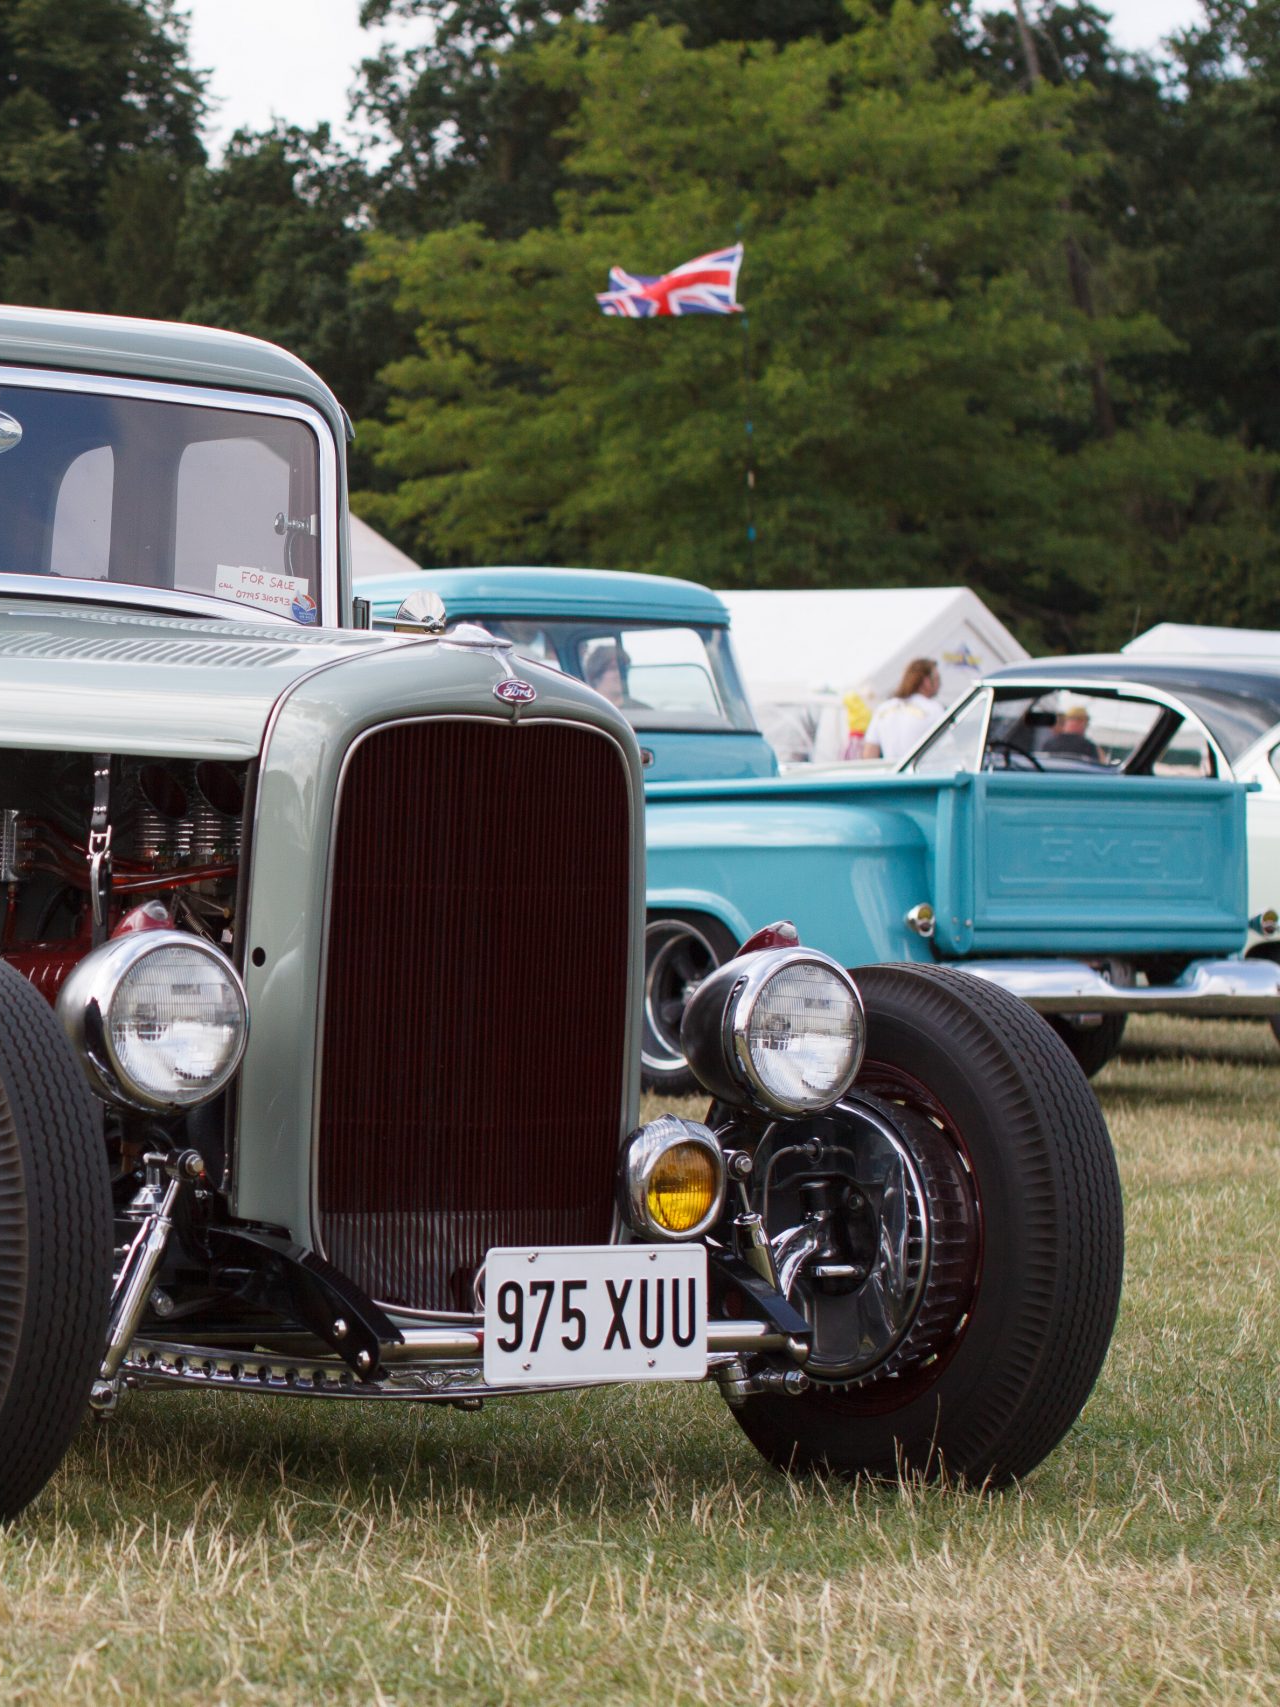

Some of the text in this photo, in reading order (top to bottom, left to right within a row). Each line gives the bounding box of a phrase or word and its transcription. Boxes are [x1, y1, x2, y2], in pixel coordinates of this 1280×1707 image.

[241, 571, 295, 591] FOR SALE
[502, 682, 533, 698] Ford
[497, 1277, 696, 1353] 975 XUU
